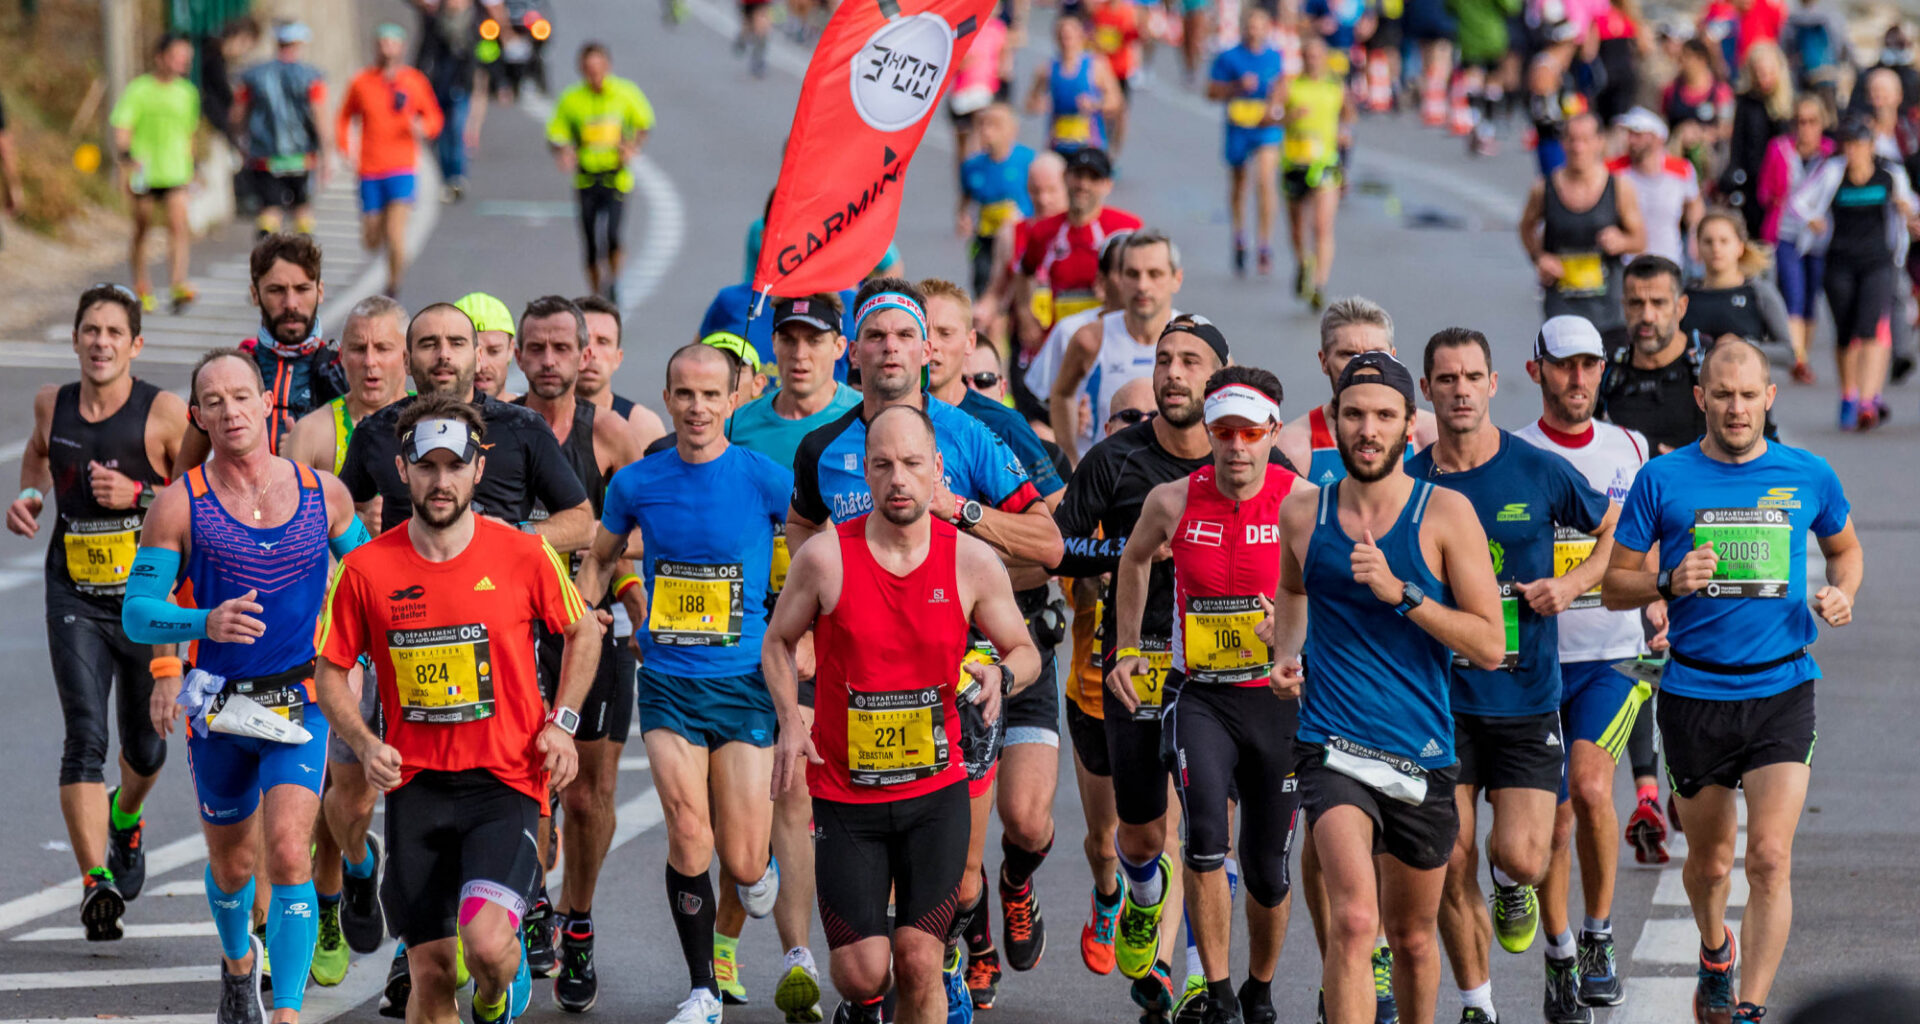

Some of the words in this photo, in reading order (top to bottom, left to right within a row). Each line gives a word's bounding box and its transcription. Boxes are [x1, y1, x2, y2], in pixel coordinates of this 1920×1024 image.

[1766, 511, 1783, 522] 06
[1246, 524, 1280, 544] DEN
[1719, 541, 1770, 561] 20093
[719, 566, 738, 578] 06
[390, 603, 426, 613] Triathlon
[678, 594, 705, 613] 188
[400, 610, 426, 620] Belfort
[405, 629, 456, 640] DÉPARTEMENT
[460, 625, 481, 640] 06
[1214, 629, 1241, 649] 106
[416, 662, 449, 684] 824
[921, 690, 937, 704] 06
[875, 727, 906, 748] 221
[1281, 779, 1298, 792] EY
